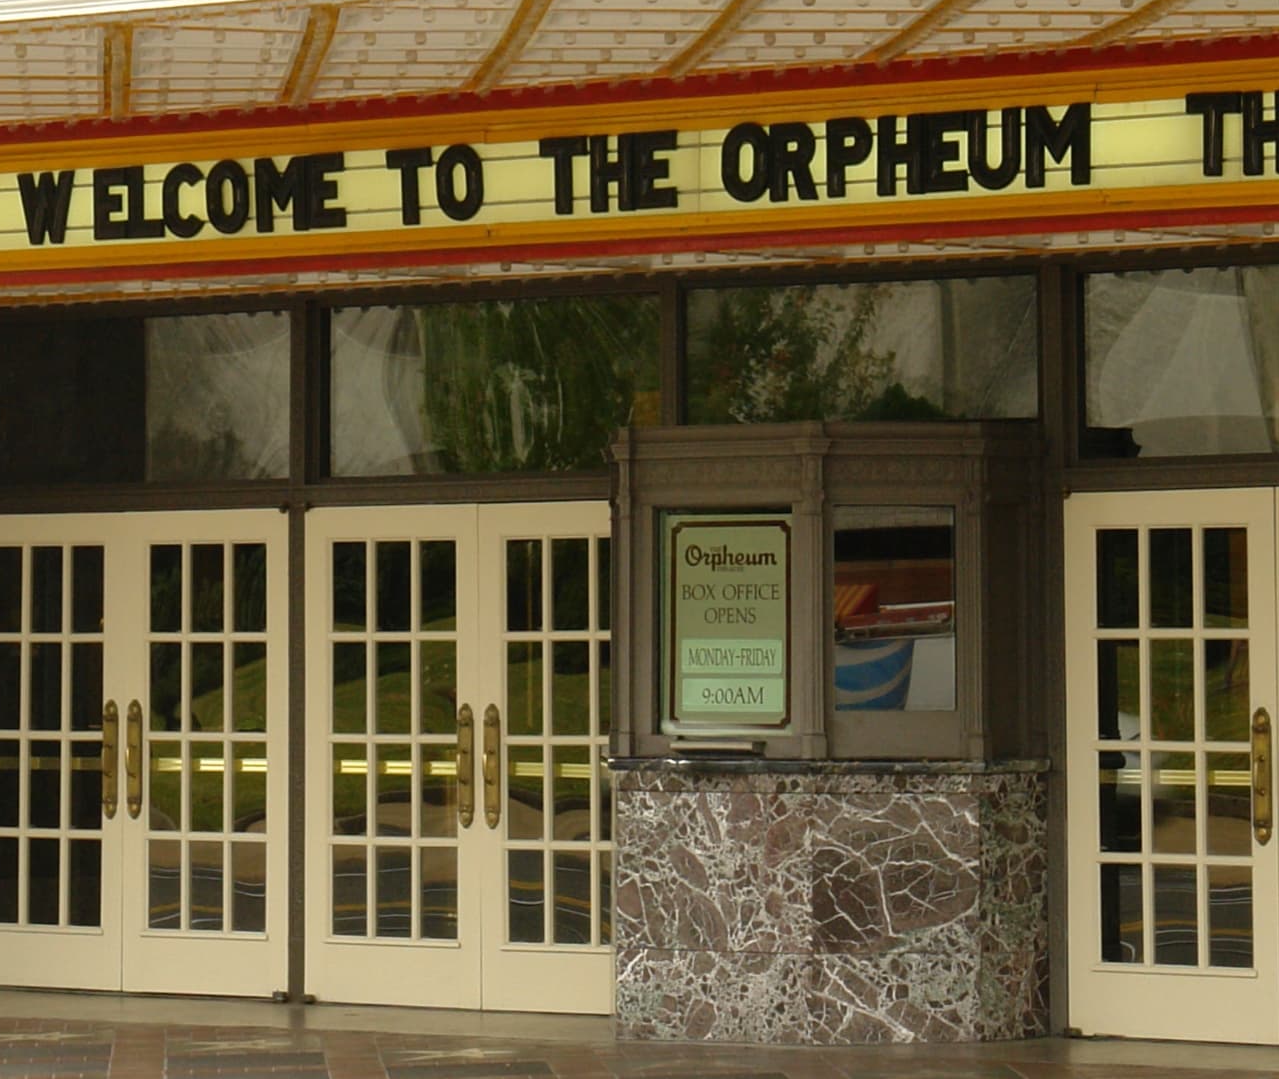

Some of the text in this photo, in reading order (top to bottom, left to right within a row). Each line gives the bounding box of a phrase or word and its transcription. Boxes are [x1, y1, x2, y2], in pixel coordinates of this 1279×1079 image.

[17, 151, 350, 246] WELCOME
[386, 143, 486, 226] TO
[540, 128, 679, 215] THE
[721, 103, 1093, 202] ORPHEUM
[685, 544, 778, 572] Orpheum
[681, 584, 780, 601] BOX OFFICE
[703, 607, 757, 624] OPENS
[688, 648, 777, 667] MONDAY-FRIDAY
[701, 686, 764, 704] 9:00AM
